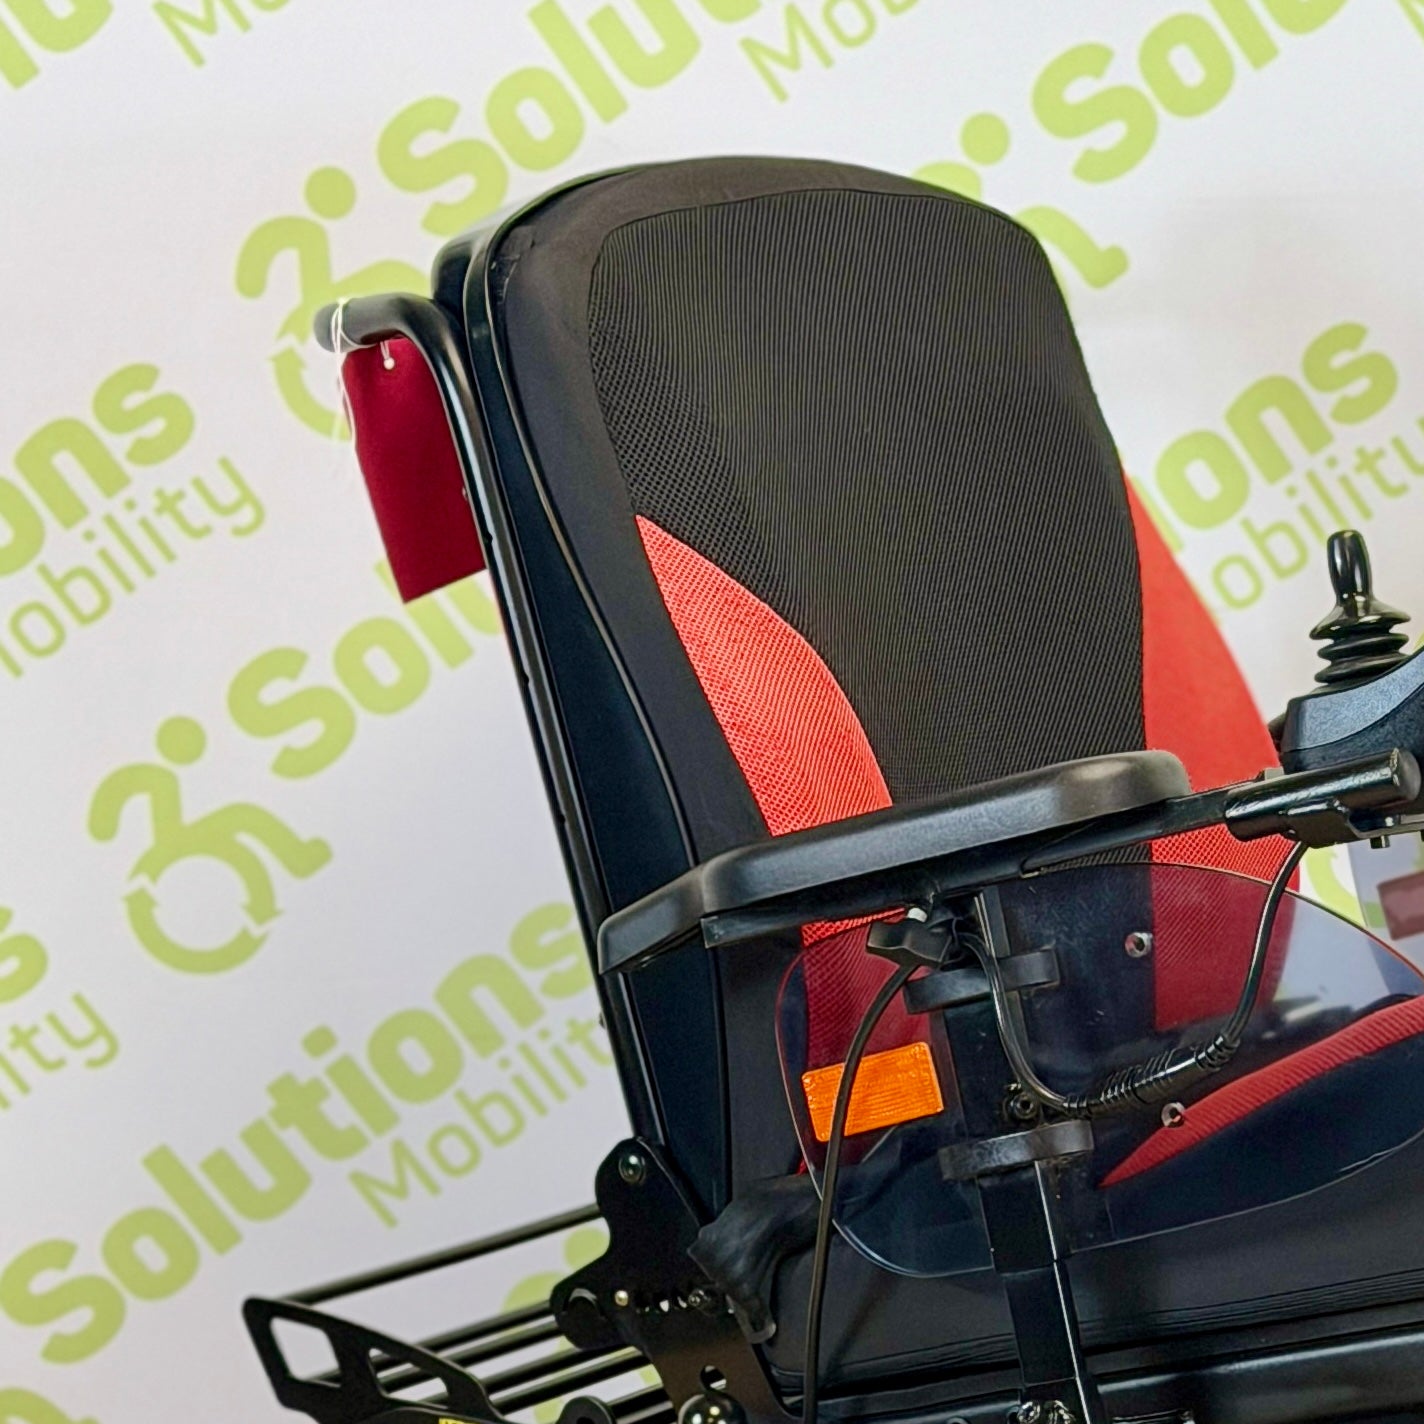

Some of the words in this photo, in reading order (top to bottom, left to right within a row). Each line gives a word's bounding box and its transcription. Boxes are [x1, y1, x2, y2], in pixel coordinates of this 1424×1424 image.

[0, 456, 267, 678] obility
[0, 902, 594, 1366] Solutions
[349, 1018, 612, 1227] Mobilit
